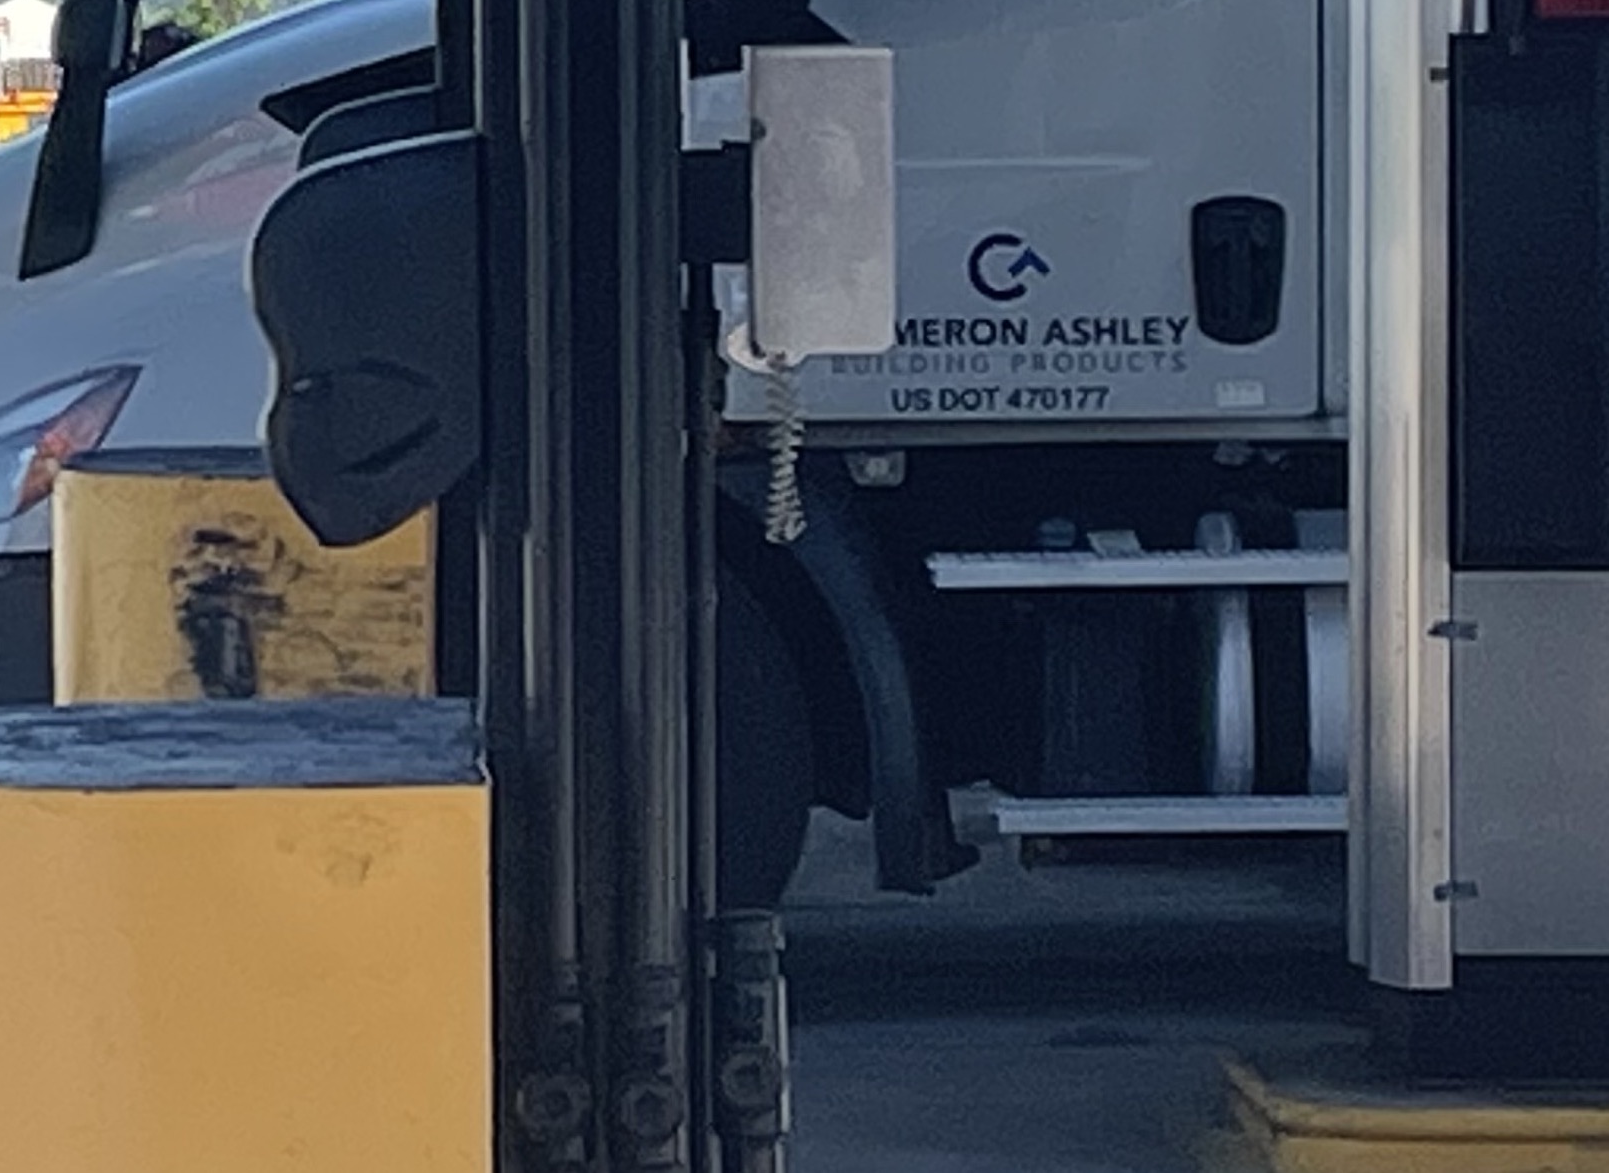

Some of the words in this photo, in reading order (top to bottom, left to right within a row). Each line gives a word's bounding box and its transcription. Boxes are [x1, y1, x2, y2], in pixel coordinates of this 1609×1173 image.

[893, 318, 1027, 348] MERON
[1042, 317, 1189, 347] ASHLEY
[831, 352, 990, 375] BUILDING
[1011, 352, 1187, 374] PRODUCTS
[891, 388, 932, 412] US
[938, 386, 1001, 412] DOT
[1007, 386, 1110, 411] 470177
